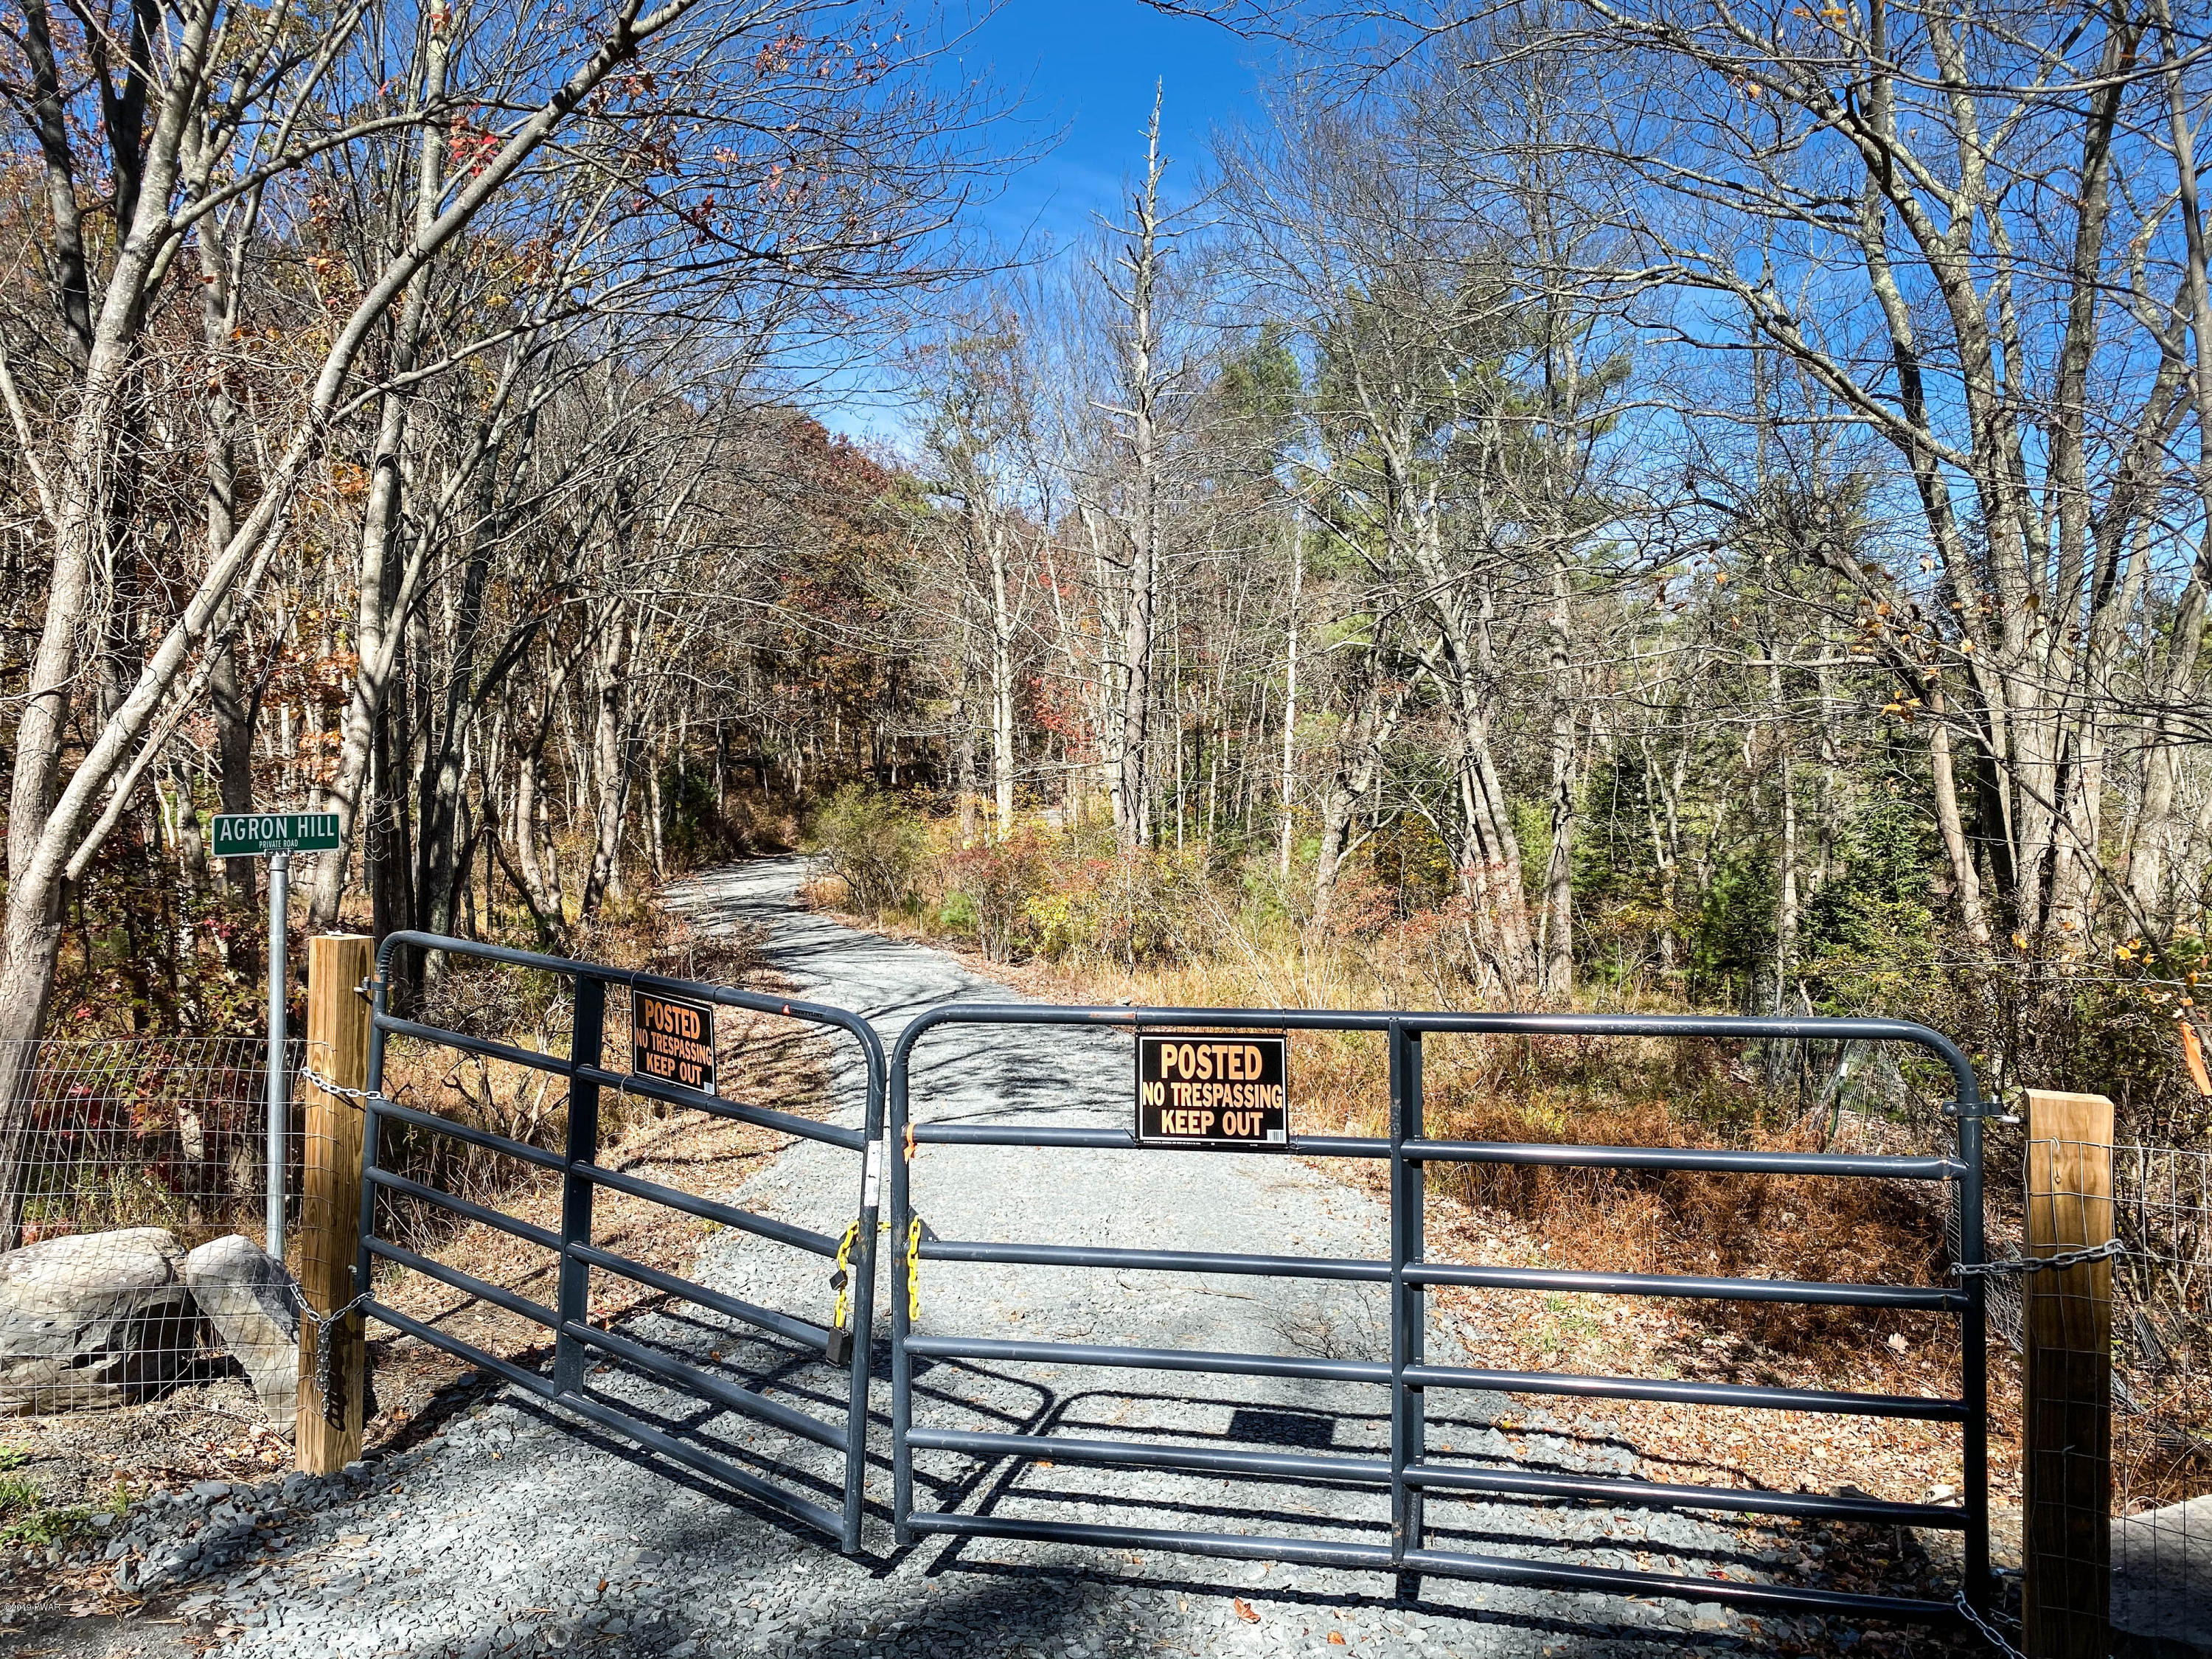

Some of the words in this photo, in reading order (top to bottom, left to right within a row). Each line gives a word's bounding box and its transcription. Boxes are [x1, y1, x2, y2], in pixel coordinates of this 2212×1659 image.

[220, 817, 287, 841] AGRON
[298, 815, 334, 838] HILL
[259, 840, 281, 849] PRIVATE
[283, 839, 298, 847] ROAD
[645, 999, 700, 1040] POSTED
[636, 1027, 648, 1048] NO
[650, 1032, 712, 1066] TRESPASSING
[1161, 1043, 1262, 1080] POSTED
[646, 1052, 675, 1077] KEEP
[679, 1062, 702, 1085] OUT
[1142, 1081, 1165, 1107] NO
[1170, 1082, 1283, 1109] TRESPASSING
[1161, 1109, 1215, 1135] KEEP
[1222, 1110, 1264, 1136] OUT
